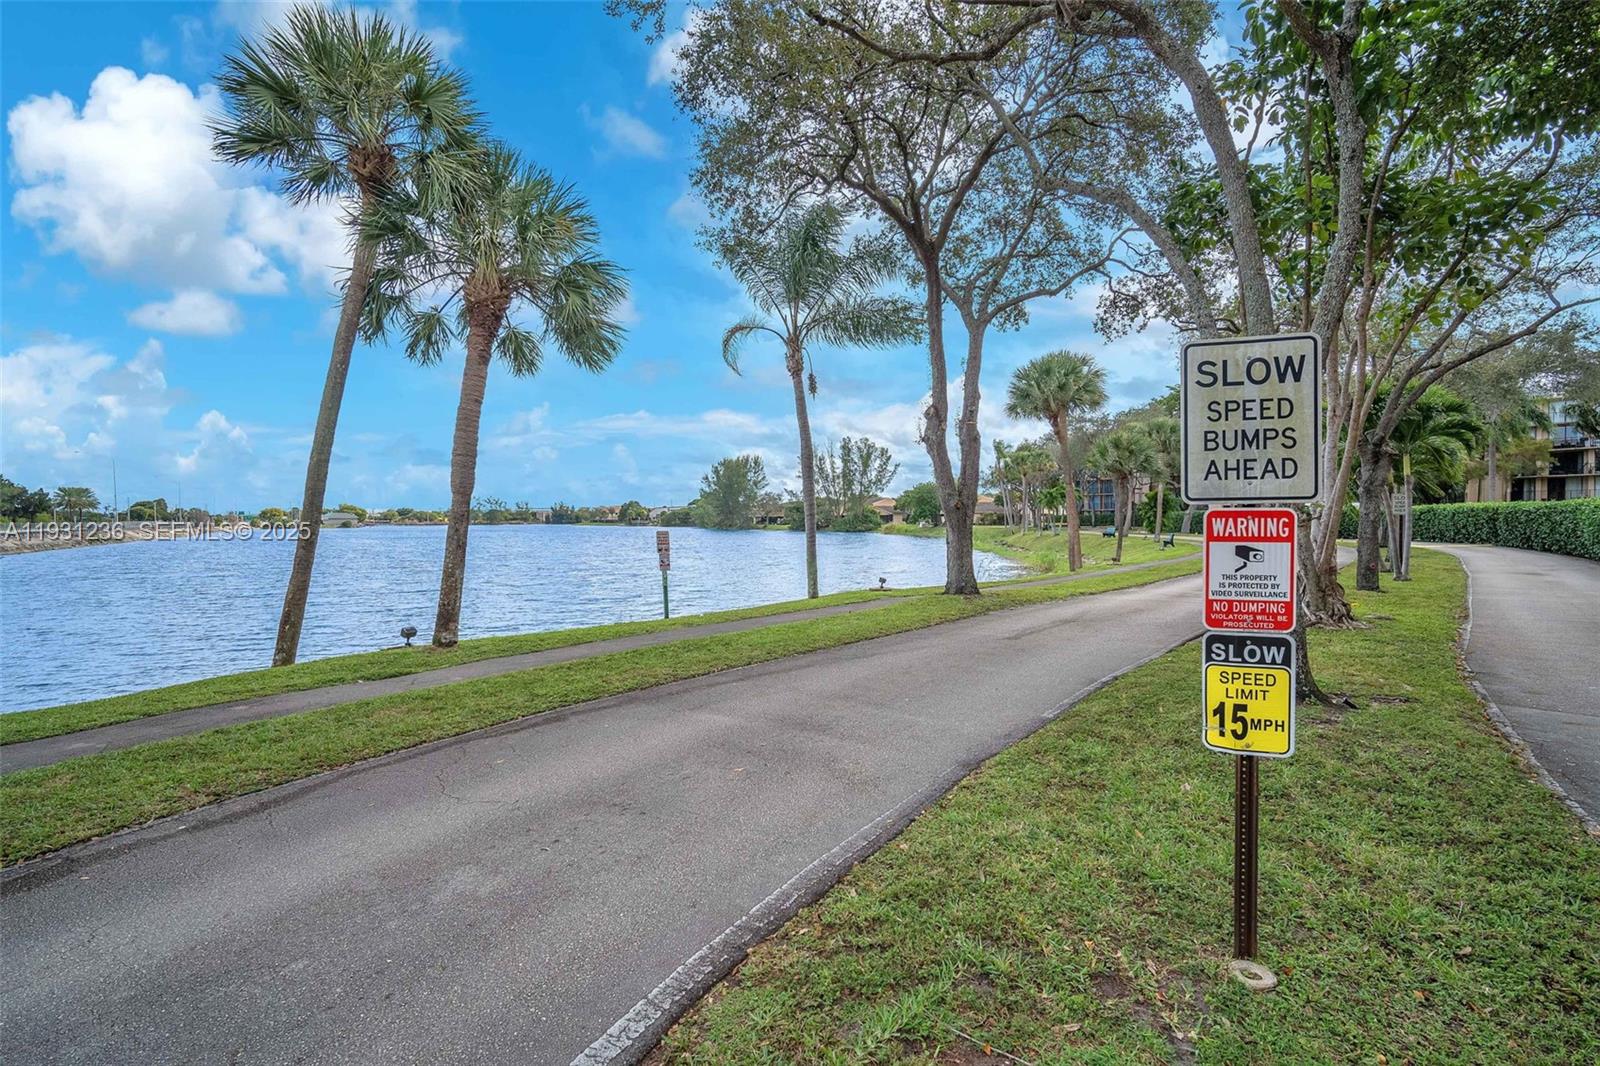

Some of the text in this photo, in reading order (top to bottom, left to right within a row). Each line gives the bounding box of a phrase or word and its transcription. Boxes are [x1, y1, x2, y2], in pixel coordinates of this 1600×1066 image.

[1195, 354, 1306, 388] SLOW
[1207, 397, 1294, 422] SPEED
[1203, 427, 1297, 452] BUMPS
[1203, 457, 1298, 481] AHEAD
[1211, 517, 1290, 538] WARNING
[1228, 582, 1269, 590] PROTECTED
[1240, 574, 1278, 582] PROPERTY
[1212, 601, 1286, 614] NO DUMPING
[1223, 621, 1275, 629] PROSECUTED
[1210, 643, 1286, 664] SLOW
[1219, 671, 1277, 687] SPEED
[1225, 687, 1270, 701] LIMIT
[1212, 701, 1285, 741] 15 MPH
